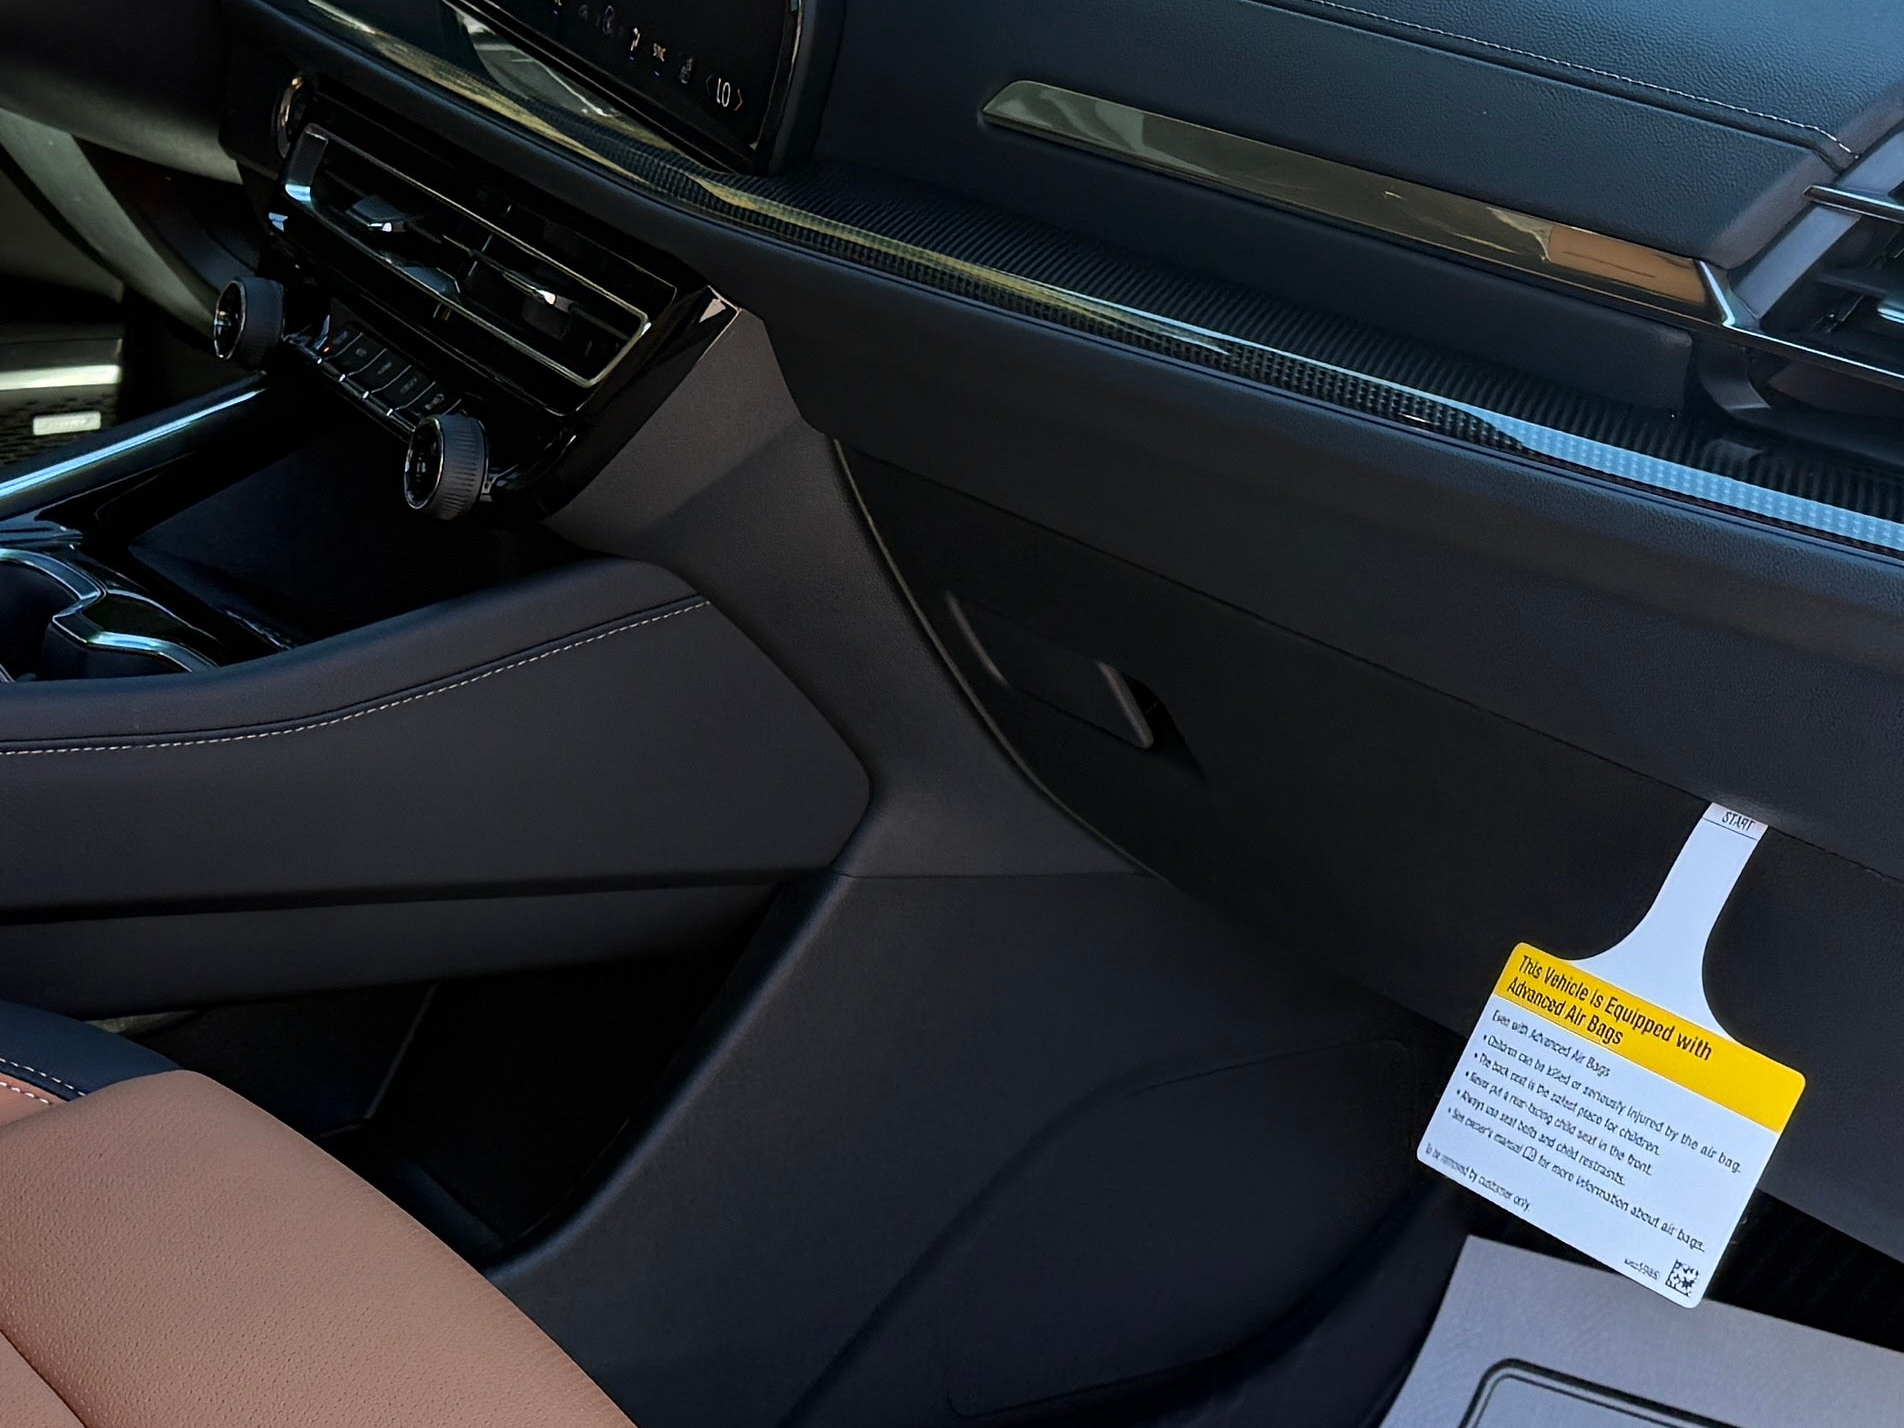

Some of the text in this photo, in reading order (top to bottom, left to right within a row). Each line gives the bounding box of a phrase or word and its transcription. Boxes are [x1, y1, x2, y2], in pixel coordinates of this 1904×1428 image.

[1722, 811, 1756, 832] START
[1505, 975, 1624, 1048] Advanced Air Bags
[1518, 954, 1543, 980] This
[1541, 965, 1589, 1002] Vehicle
[1603, 995, 1676, 1043] Equipped
[1675, 1032, 1713, 1061] with
[1527, 1028, 1573, 1058] Advanced
[1569, 1048, 1587, 1065] Air
[1585, 1056, 1611, 1078] Bags
[1459, 1089, 1486, 1112] Always
[1498, 1112, 1519, 1129] seat
[1537, 1132, 1557, 1149] and
[1555, 1142, 1580, 1162] child
[1478, 1051, 1492, 1069] The
[1491, 1059, 1510, 1079] back
[1549, 1092, 1579, 1113] safest
[1575, 1106, 1603, 1126] place
[1603, 1117, 1619, 1134] for
[1487, 1034, 1519, 1059] Children
[1517, 1052, 1534, 1067] can
[1570, 1080, 1583, 1091] or
[1582, 1086, 1627, 1116] seriously
[1626, 1105, 1665, 1133] injured
[1664, 1124, 1680, 1142] by
[1679, 1132, 1699, 1151] the
[1699, 1145, 1718, 1159] air
[1717, 1151, 1742, 1174] bag.
[1488, 1084, 1504, 1098] put
[1553, 1117, 1577, 1136] child
[1576, 1129, 1598, 1147] seat
[1597, 1139, 1608, 1152] in
[1609, 1144, 1626, 1162] the
[1537, 1154, 1552, 1170] for
[1550, 1164, 1575, 1183] more
[1575, 1174, 1630, 1212] information
[1629, 1205, 1661, 1229] about
[1660, 1222, 1677, 1237] air
